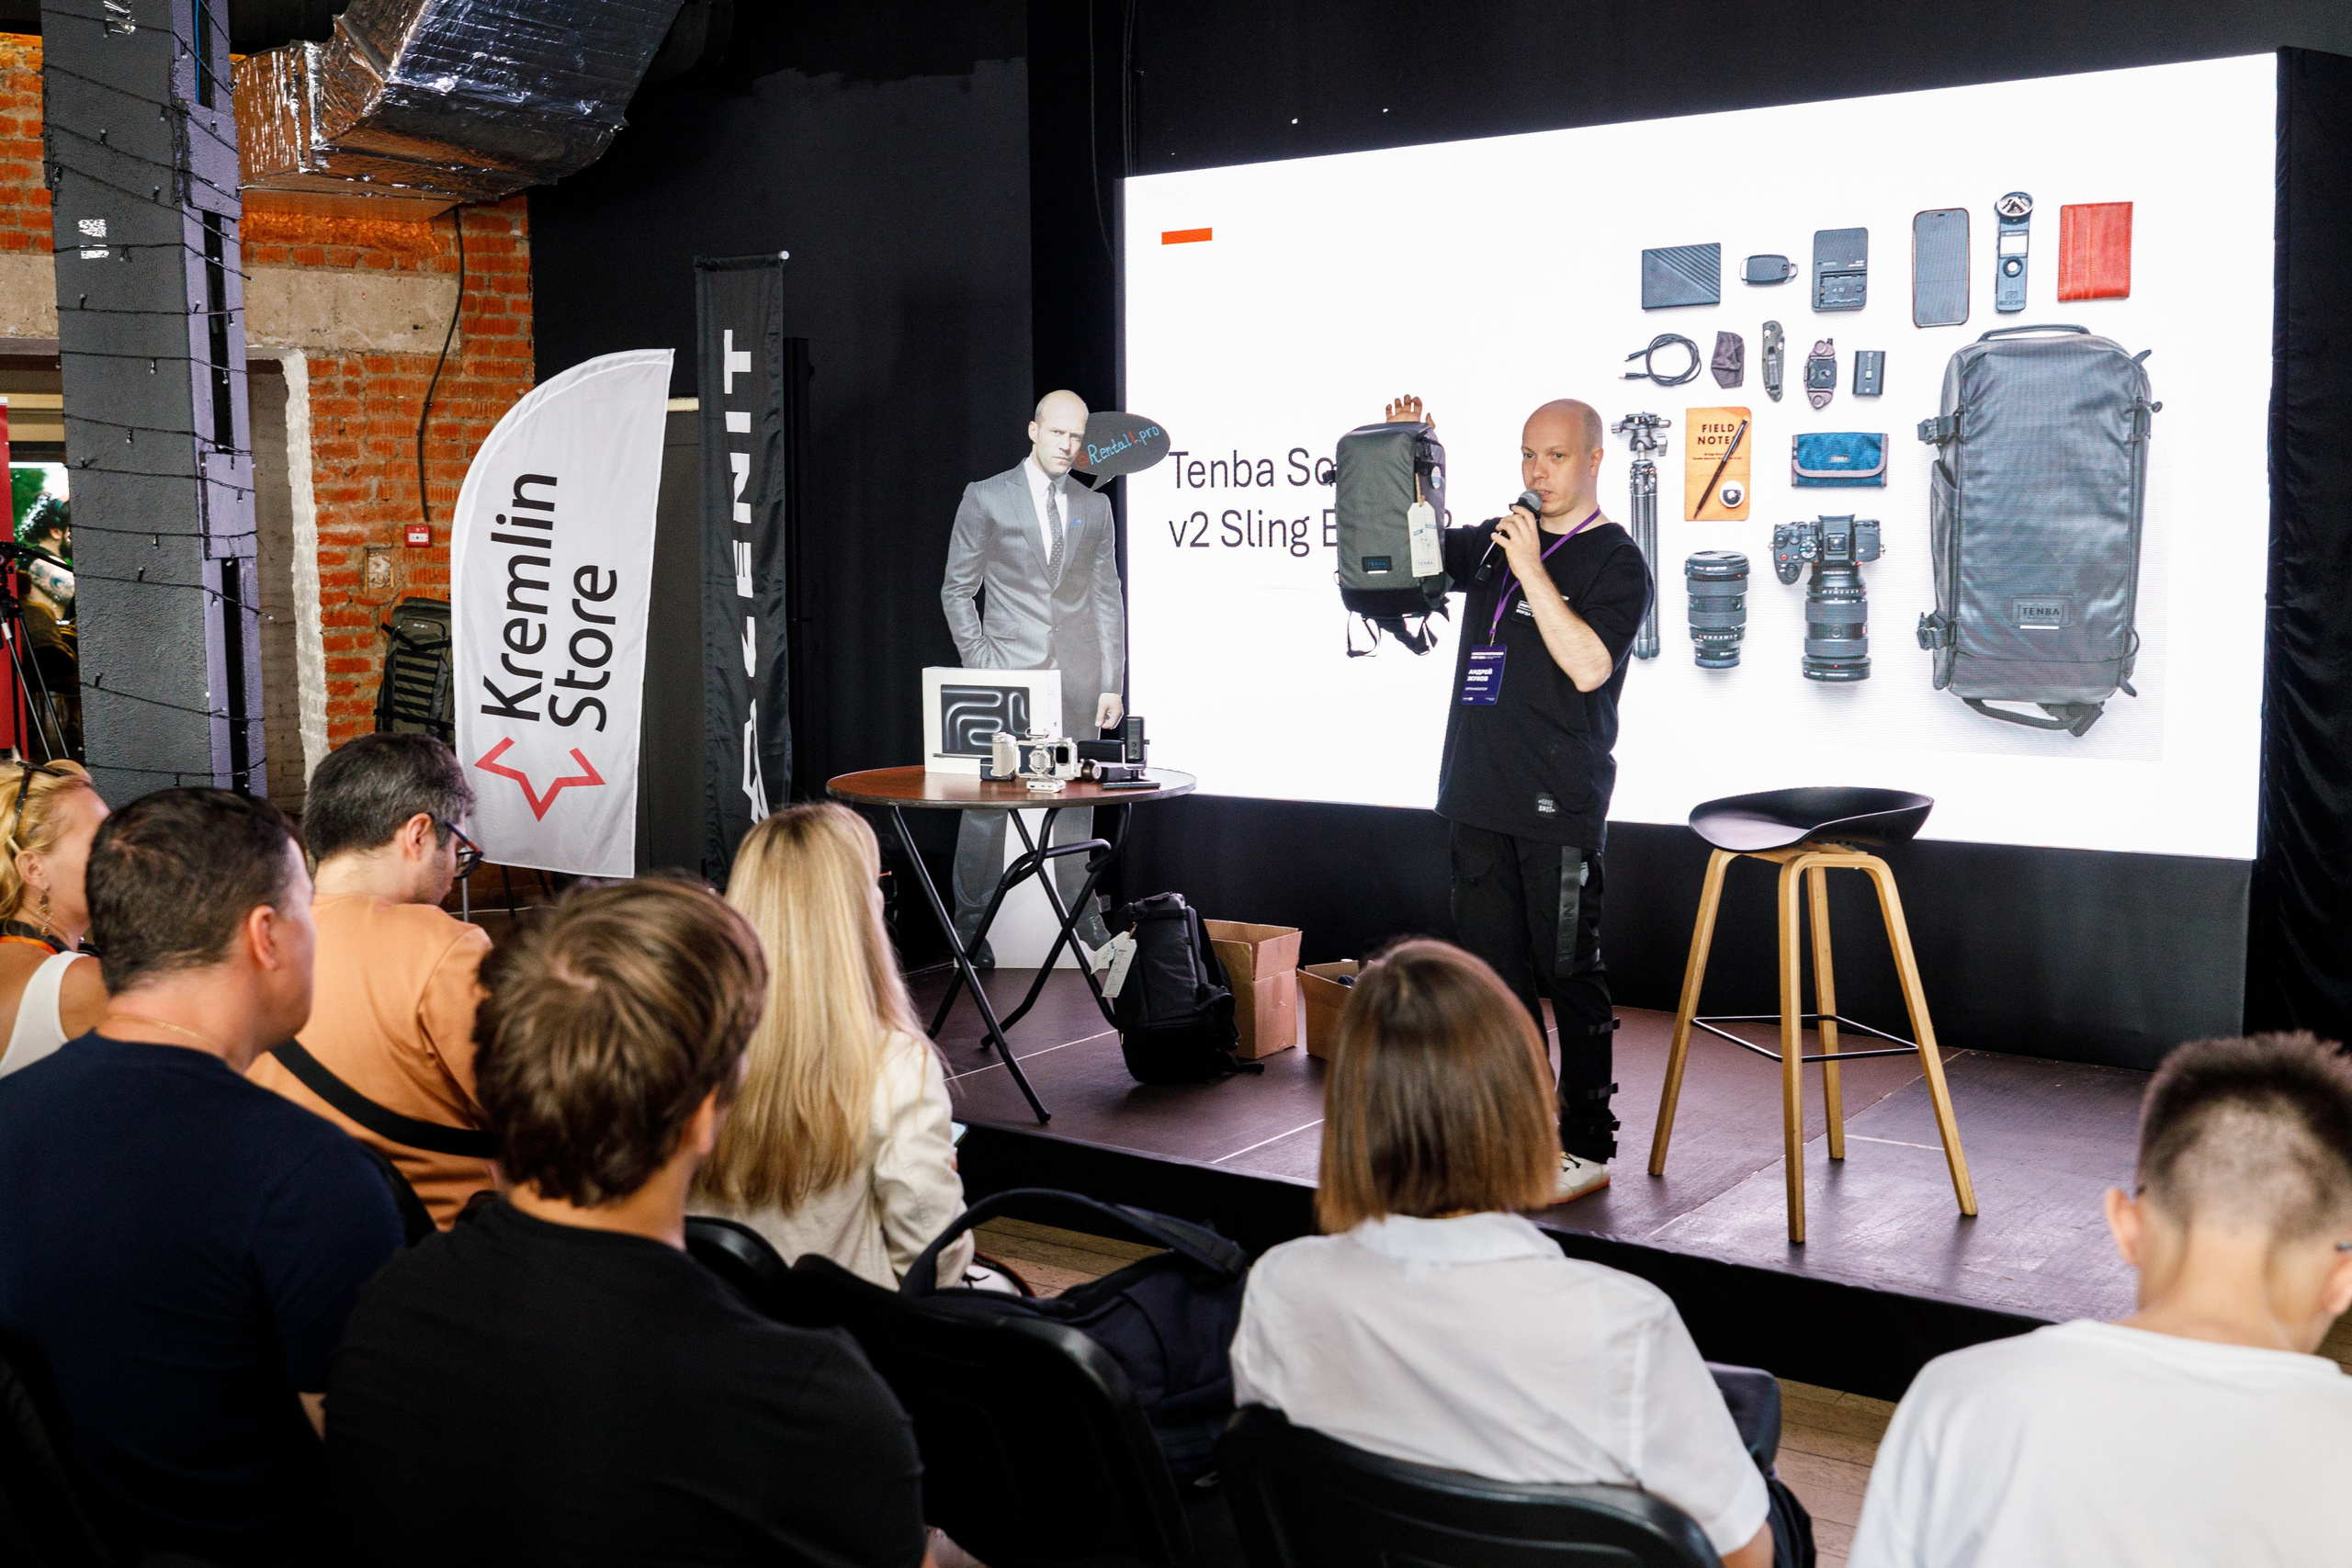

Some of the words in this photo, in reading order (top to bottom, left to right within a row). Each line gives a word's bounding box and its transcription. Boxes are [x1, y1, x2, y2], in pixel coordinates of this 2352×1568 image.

[1697, 435, 1736, 446] NOTE
[1702, 423, 1736, 433] FIELD
[1168, 449, 1274, 489] Tenba
[1168, 510, 1210, 548] v2
[1220, 509, 1310, 558] Sling
[481, 473, 558, 723] Kremlin
[2022, 607, 2060, 615] TENBA
[548, 565, 618, 734] Store
